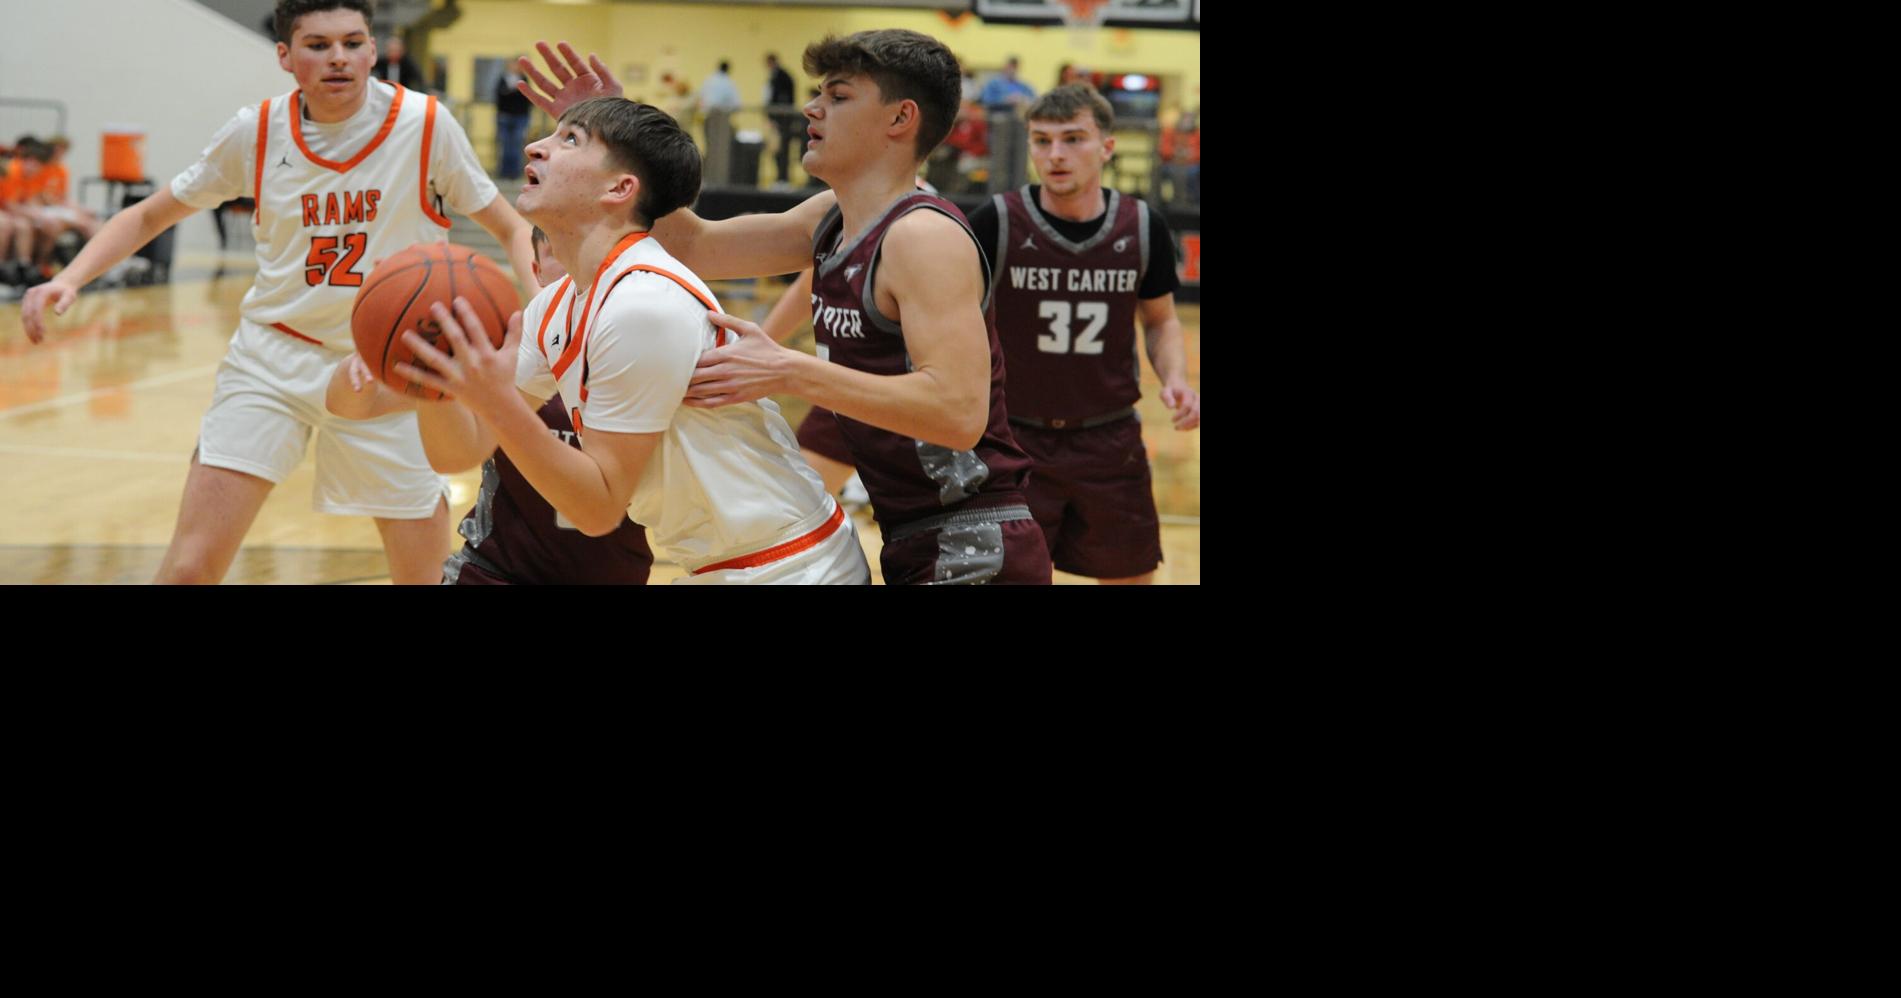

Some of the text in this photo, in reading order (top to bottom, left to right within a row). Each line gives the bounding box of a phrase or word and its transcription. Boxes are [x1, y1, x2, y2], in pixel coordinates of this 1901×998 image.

[301, 189, 381, 227] RAMS
[305, 232, 367, 287] 52
[1010, 266, 1137, 292] WEST CARTER
[1038, 301, 1108, 354] 32
